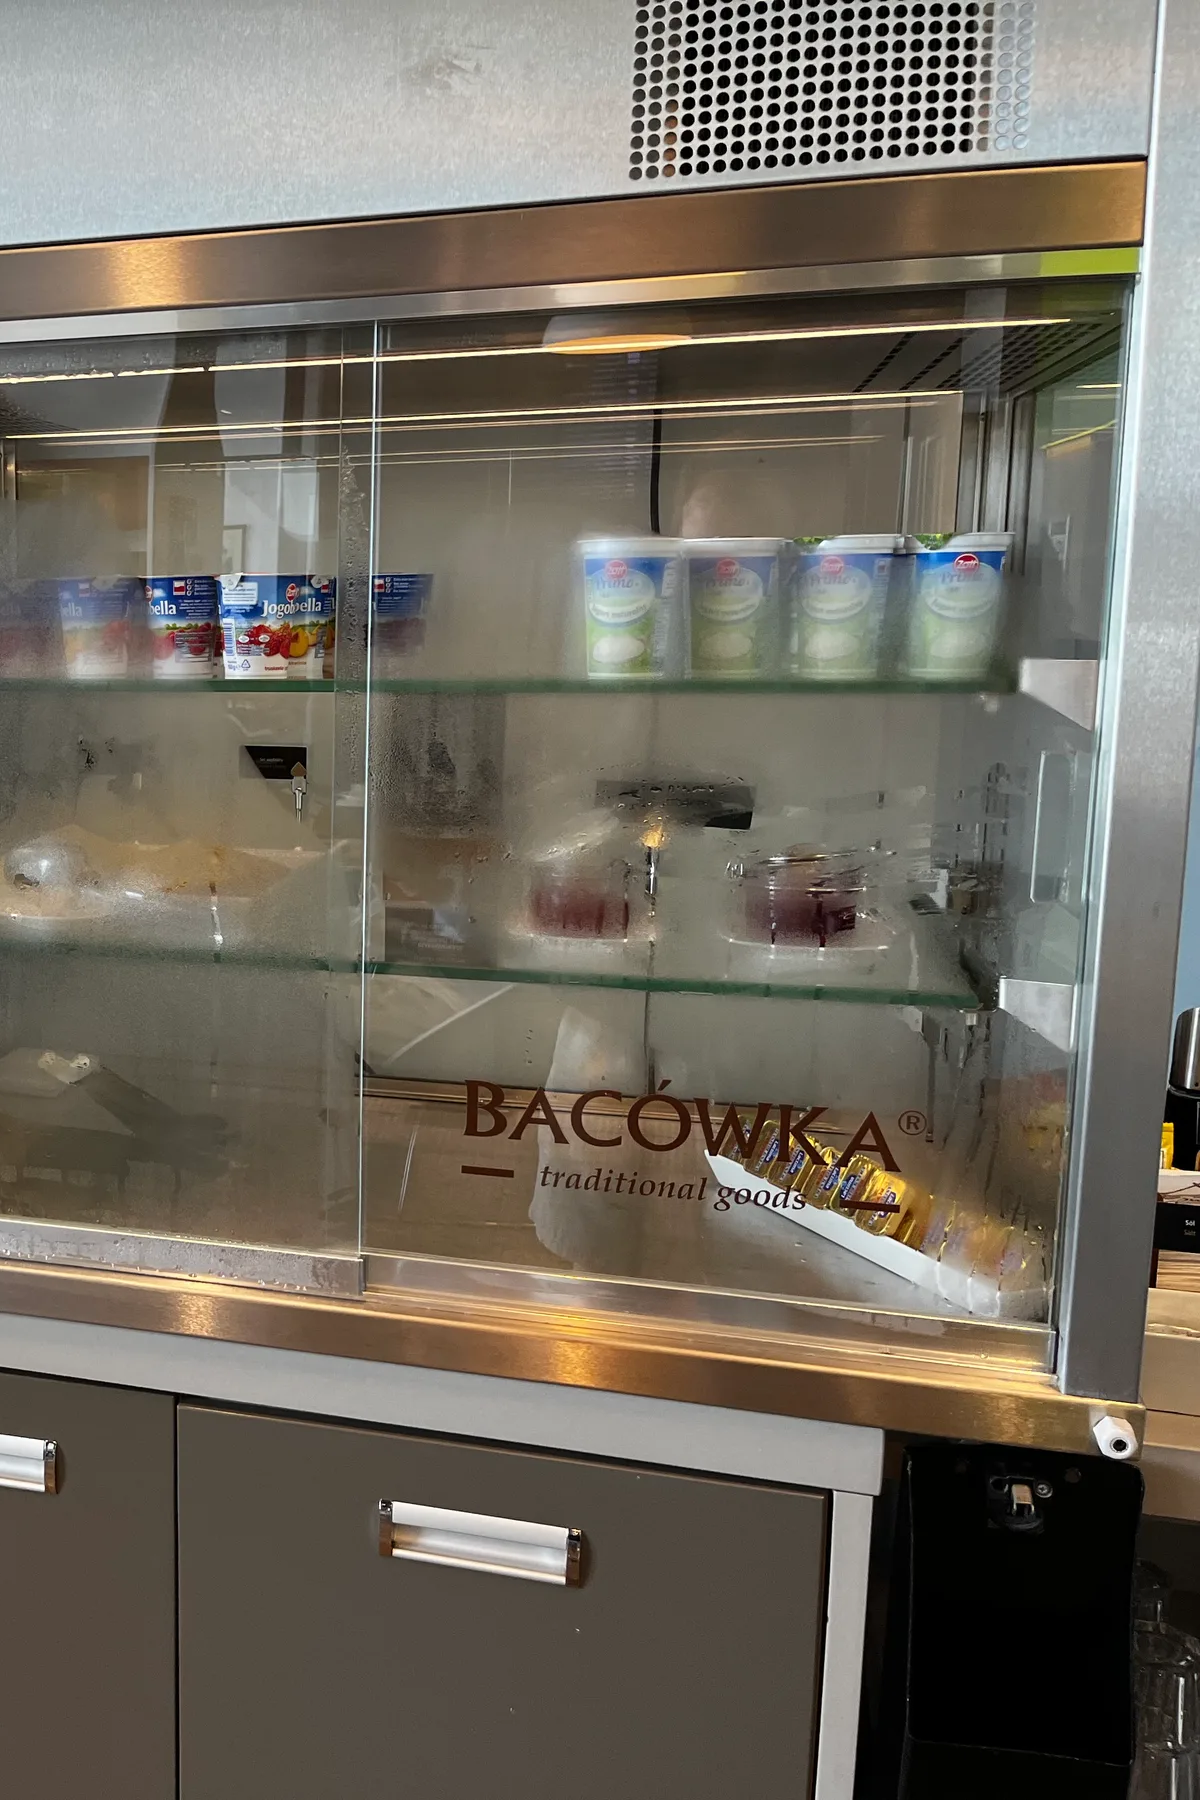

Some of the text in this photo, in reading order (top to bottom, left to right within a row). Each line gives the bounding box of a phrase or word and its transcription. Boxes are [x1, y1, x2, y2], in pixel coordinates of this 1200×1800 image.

[260, 598, 322, 619] Jogobella
[540, 1164, 707, 1201] traditional
[712, 1183, 807, 1212] goods
